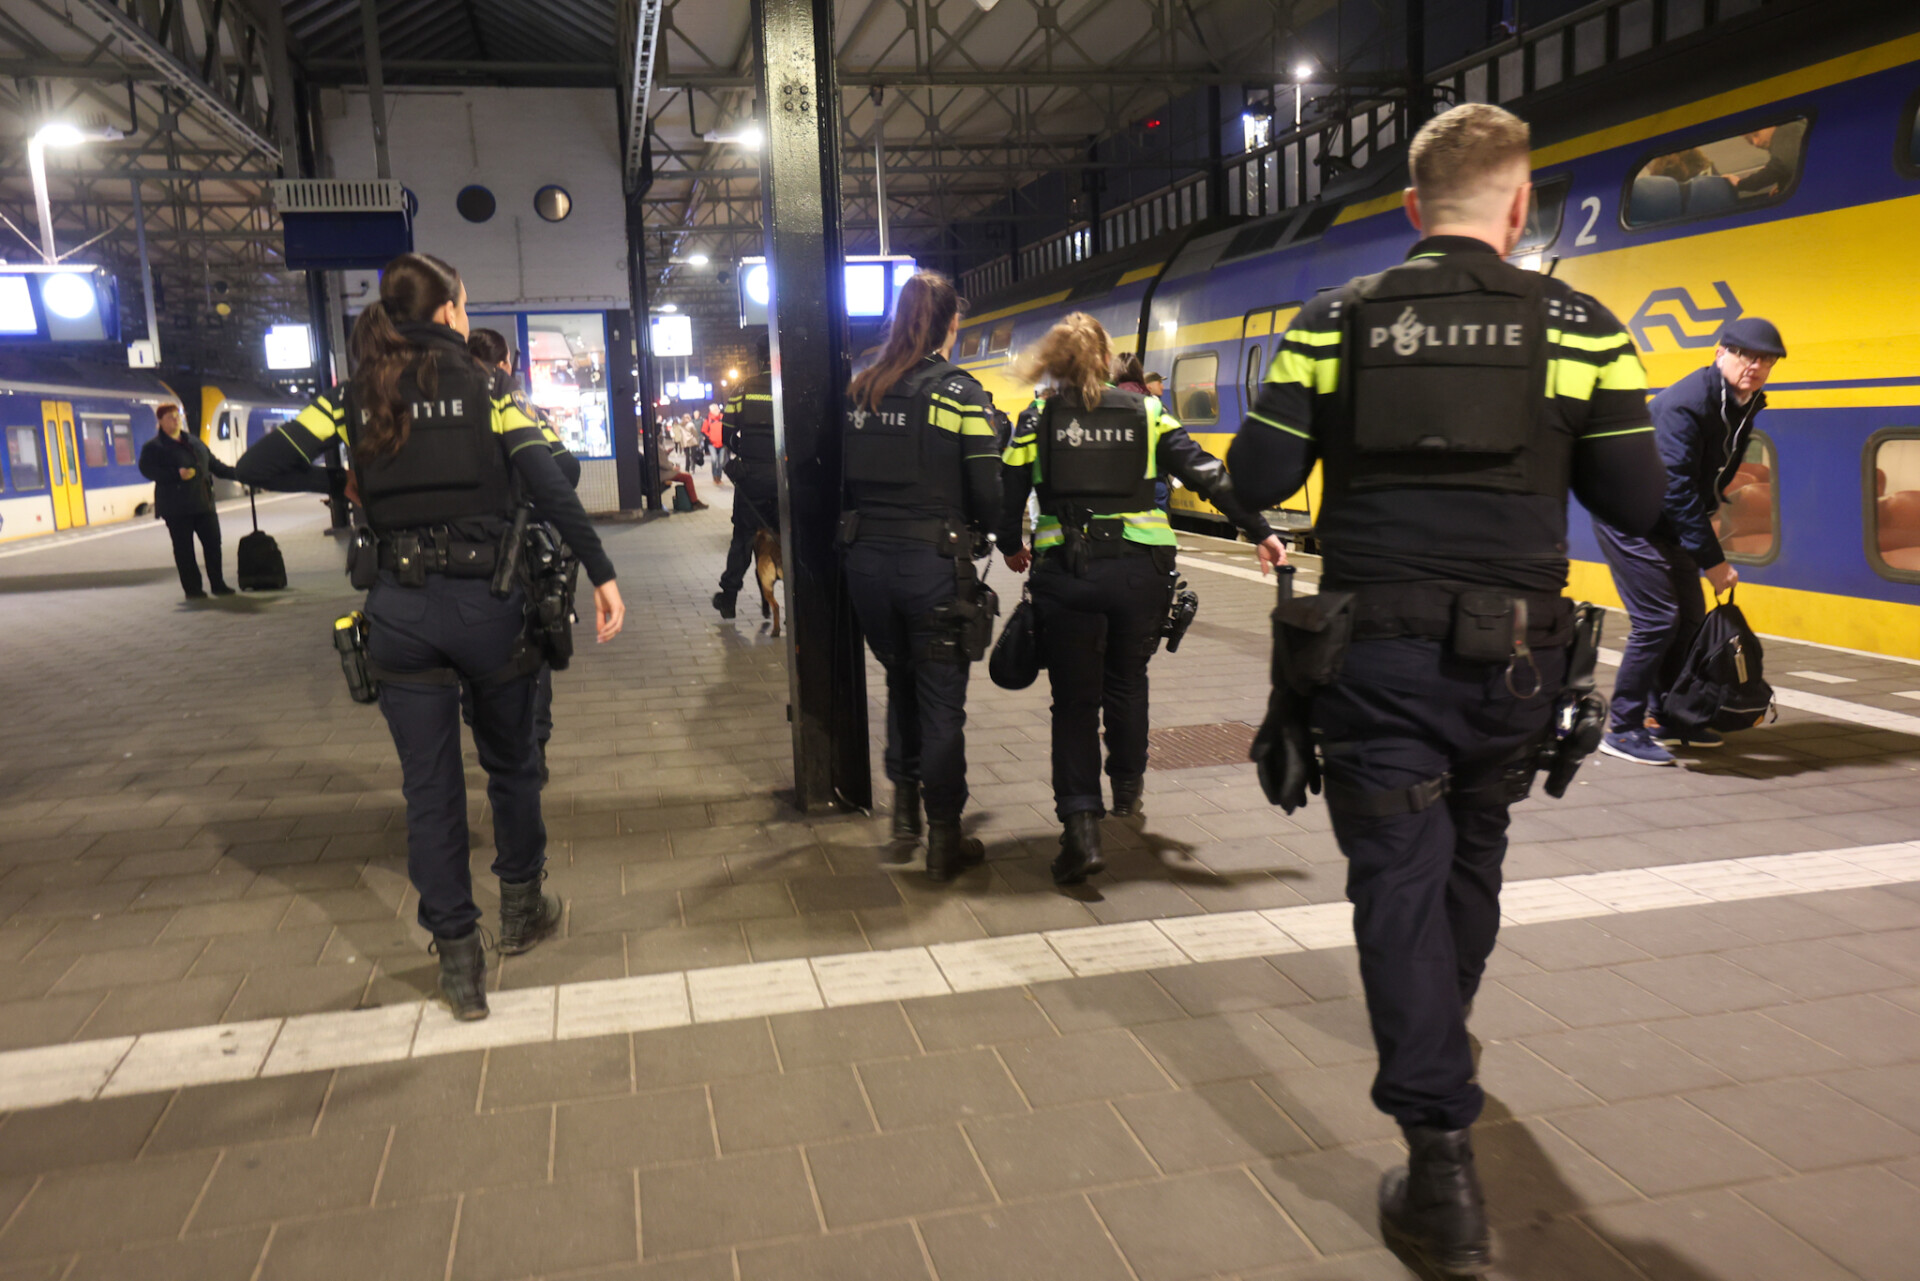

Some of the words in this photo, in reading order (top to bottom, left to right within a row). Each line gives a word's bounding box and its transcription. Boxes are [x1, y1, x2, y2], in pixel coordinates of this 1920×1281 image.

[1575, 196, 1601, 247] 2
[1370, 307, 1523, 356] POLITIE
[361, 400, 463, 425] PITIE
[1056, 419, 1134, 447] POLITIE
